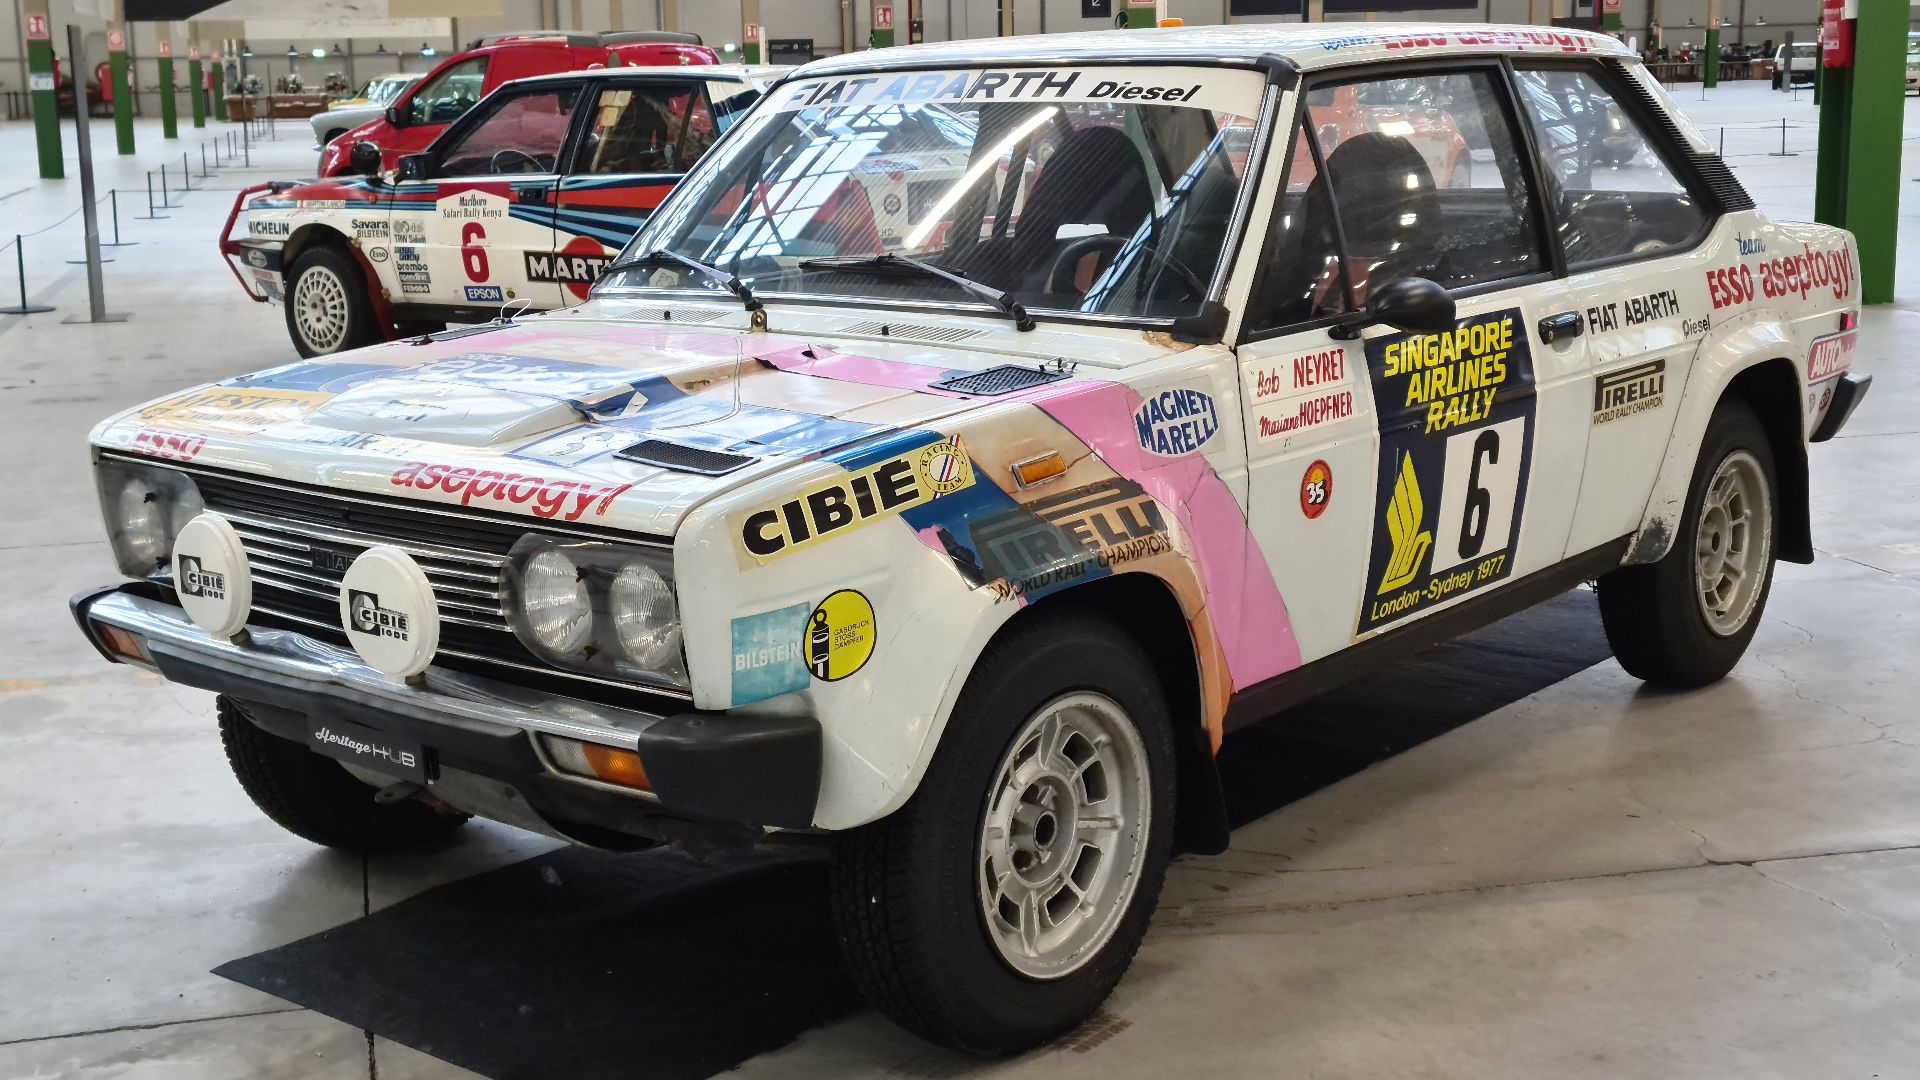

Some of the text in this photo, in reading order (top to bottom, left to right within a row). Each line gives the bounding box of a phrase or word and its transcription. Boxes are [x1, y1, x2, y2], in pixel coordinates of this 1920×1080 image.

[784, 72, 1202, 109] FIAT ABARTH Diesel
[442, 207, 502, 220] Safari Rally Kenya
[459, 193, 487, 207] Marlboro
[351, 218, 389, 230] Savara
[356, 229, 389, 239] BILSTEIN
[372, 250, 386, 258] Esso
[460, 221, 490, 284] 6
[1735, 231, 1766, 256] team
[1706, 234, 1855, 310] ESSO aseptogyl
[468, 286, 499, 300] EPSON
[1586, 289, 1680, 335] FIAT ABARTH
[1682, 313, 1711, 339] Diesel
[1383, 318, 1513, 378] SINGAPORE
[1293, 348, 1345, 389] NEYRET
[1405, 351, 1507, 408] AIRLINES
[1593, 358, 1666, 413] PIRELLI
[1134, 389, 1219, 433] MAGNETI
[1299, 390, 1353, 428] HOEPFNER
[1424, 386, 1497, 435] RALLY
[1593, 394, 1663, 426] WORLD RALLY CHAMPION
[1134, 410, 1219, 455] MARELLI
[921, 444, 960, 467] RACING
[390, 461, 633, 521] aseptogyl
[937, 476, 962, 491] TEAM
[1306, 480, 1325, 504] 35
[1458, 429, 1500, 560] 6
[742, 459, 920, 556] CIBIÉ
[1097, 534, 1171, 569] CHAMPION
[1477, 554, 1506, 579] 1977
[203, 588, 225, 601] IODE
[381, 627, 409, 642] IODE
[833, 619, 870, 636] GASDRUCK
[735, 640, 801, 671] BILSTEIN
[315, 727, 415, 767] Heritage HUB
